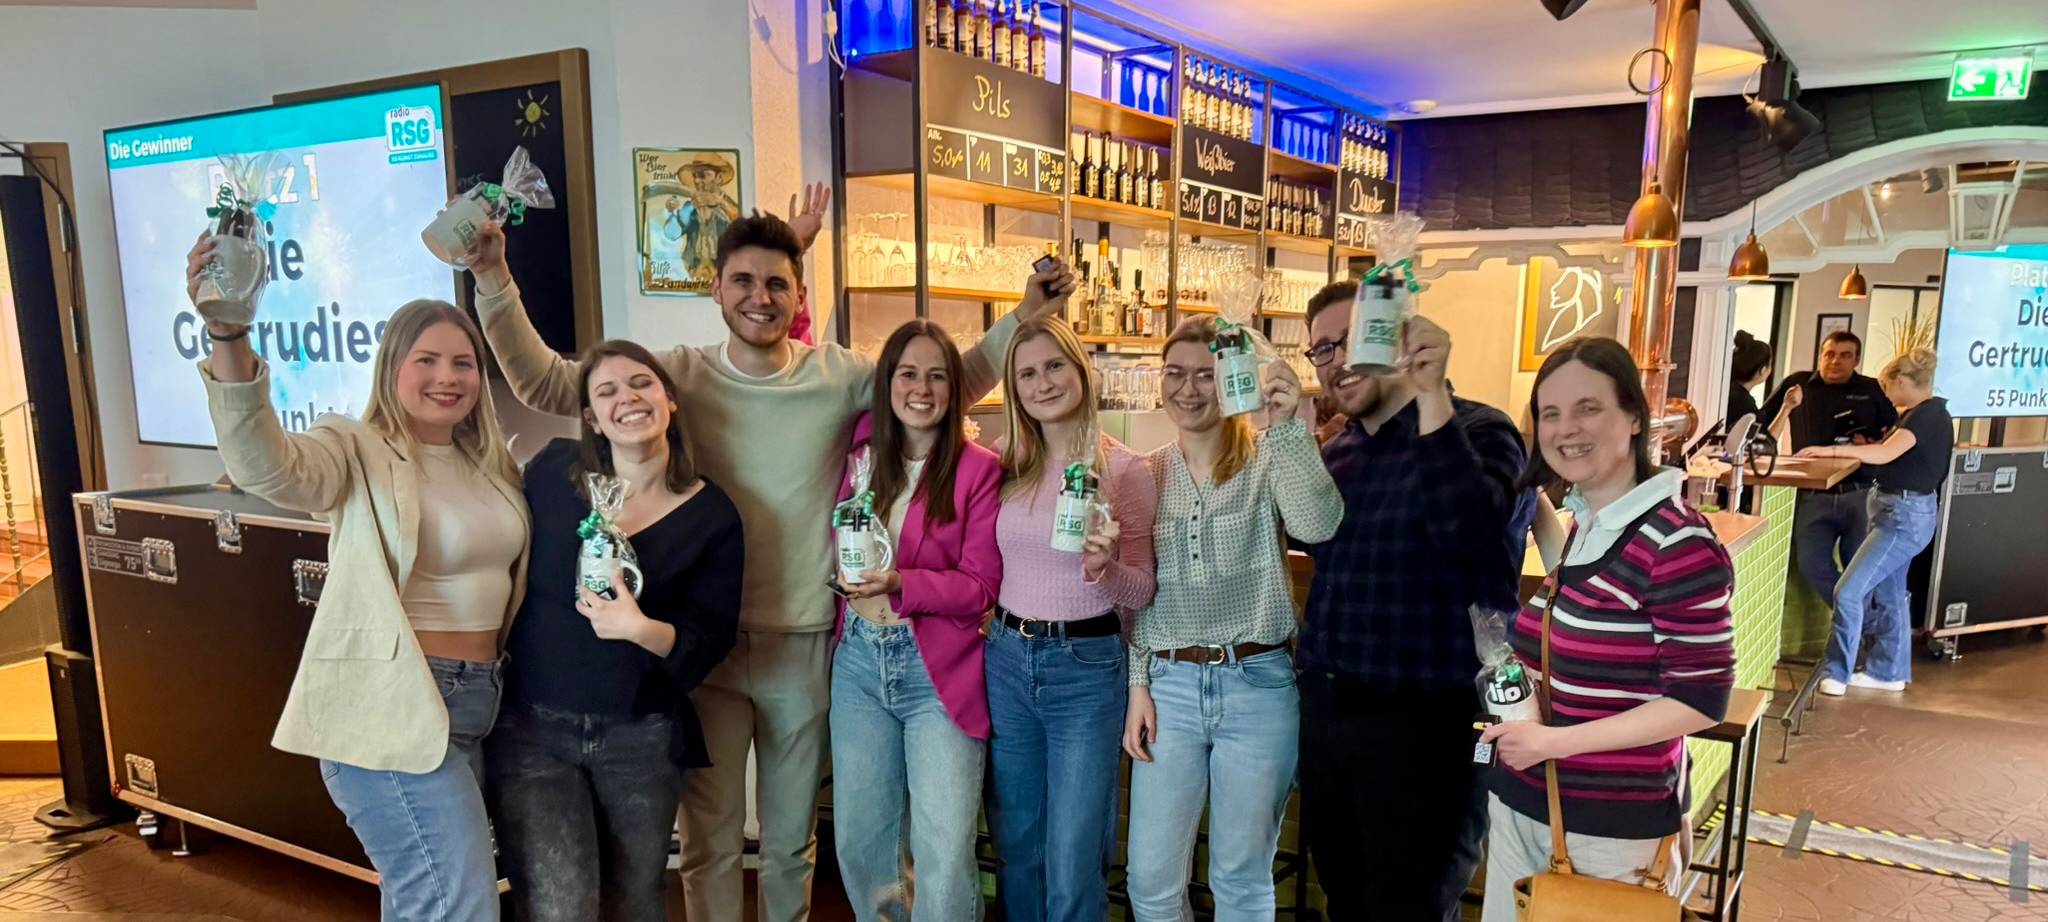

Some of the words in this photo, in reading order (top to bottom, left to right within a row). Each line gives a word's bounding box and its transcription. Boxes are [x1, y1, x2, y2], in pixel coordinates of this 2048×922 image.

[972, 75, 1011, 119] Pils
[390, 106, 410, 118] radio
[391, 118, 430, 147] RSG
[110, 140, 130, 160] Die
[132, 135, 193, 158] Gewinner
[303, 153, 320, 201] 1
[1014, 158, 1028, 178] 31
[264, 221, 305, 281] ie
[1986, 389, 2005, 407] 55
